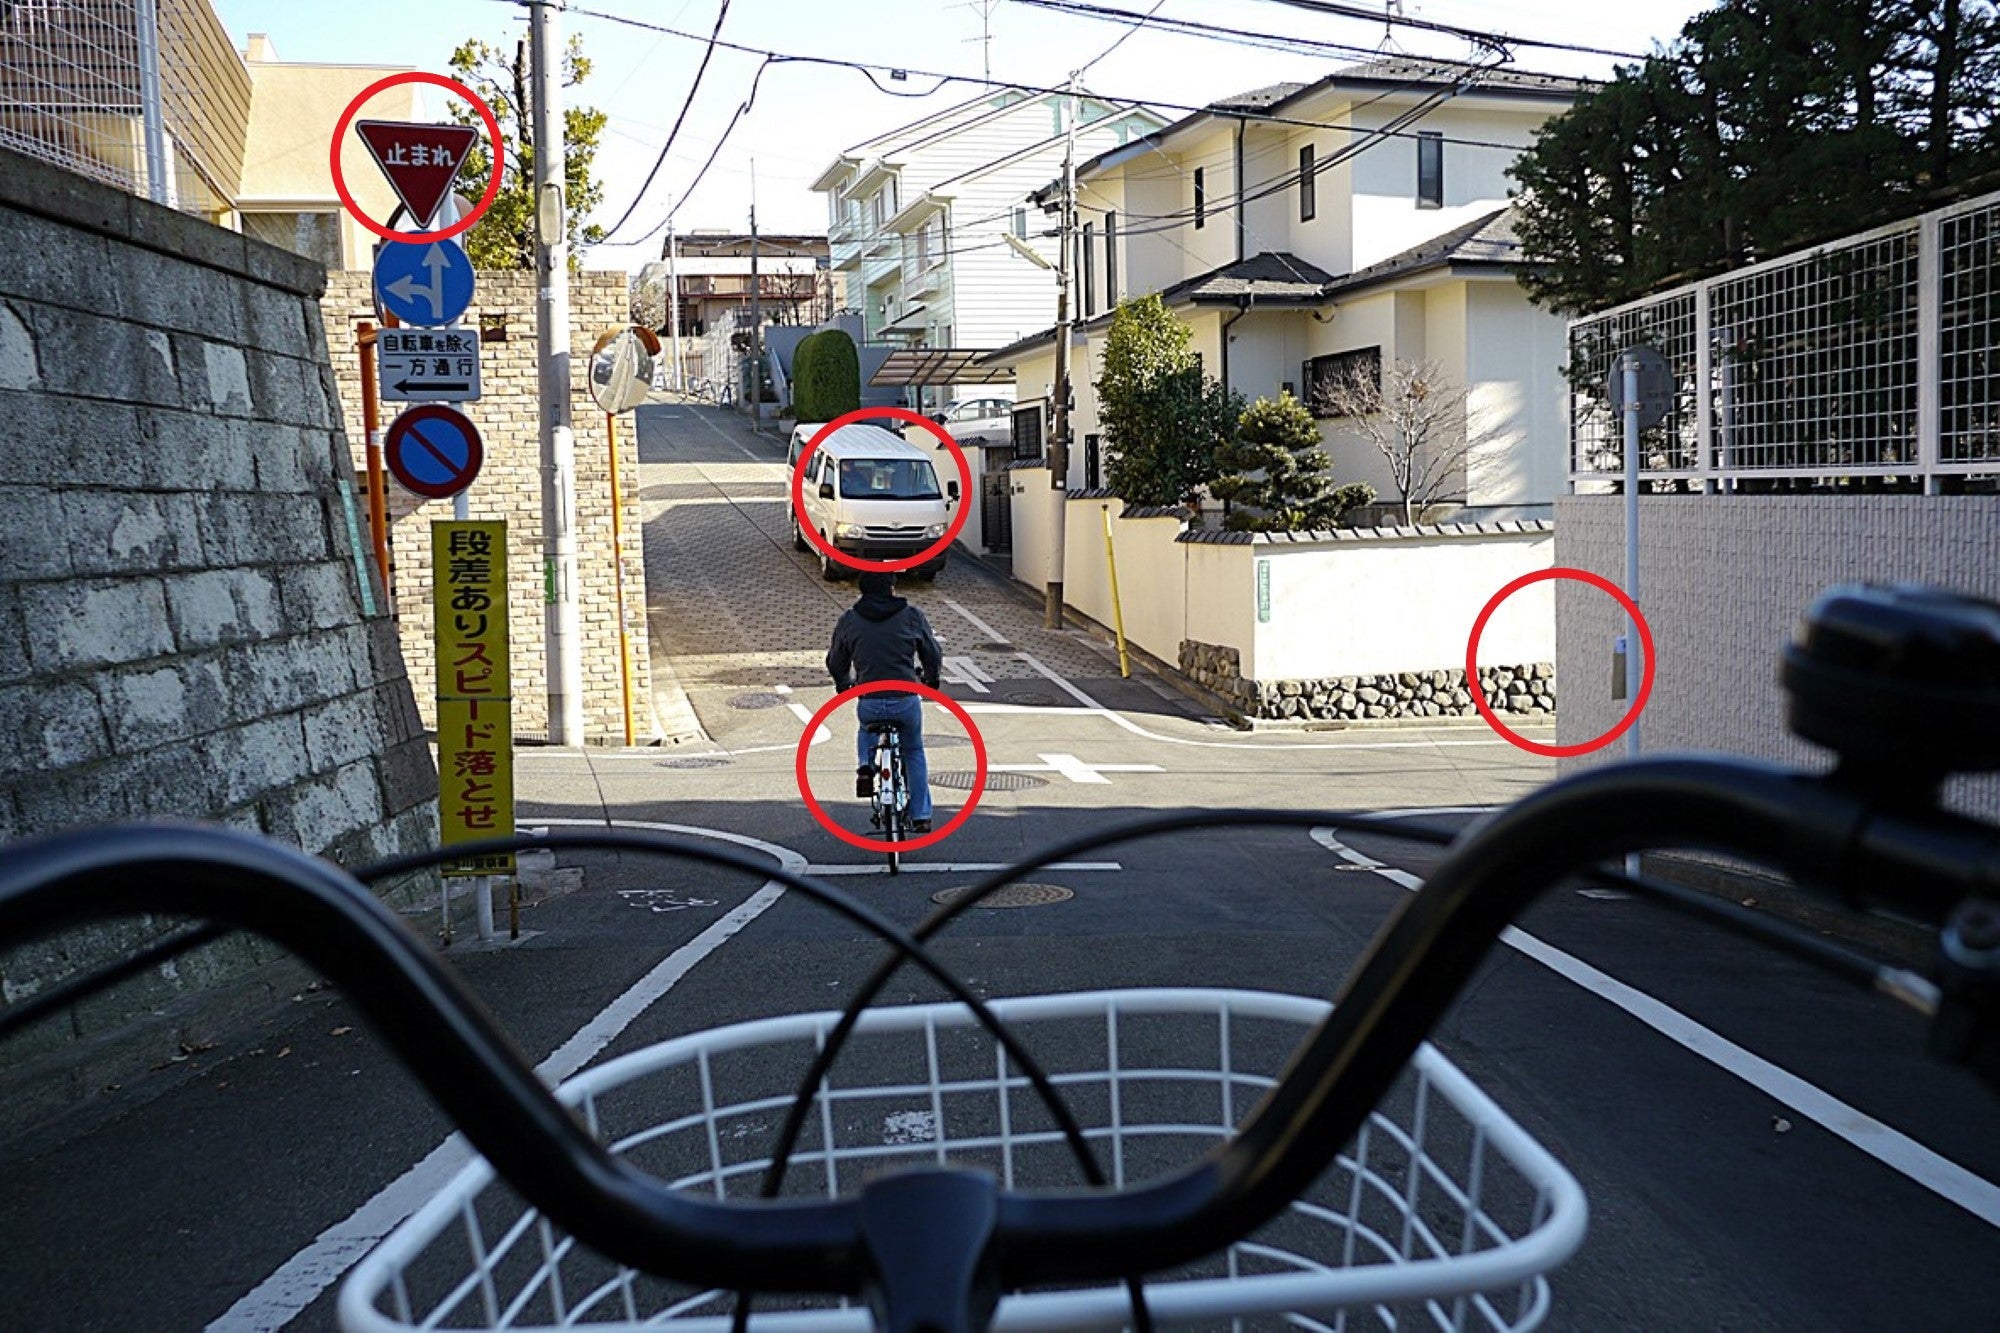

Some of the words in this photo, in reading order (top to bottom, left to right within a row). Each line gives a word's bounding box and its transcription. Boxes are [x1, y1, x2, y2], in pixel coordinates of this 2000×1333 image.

[385, 142, 455, 166] 止まれ
[384, 335, 473, 352] 自転車を除く
[385, 359, 475, 376] 一方通行
[448, 530, 497, 829] 段差ありスピード落とせ
